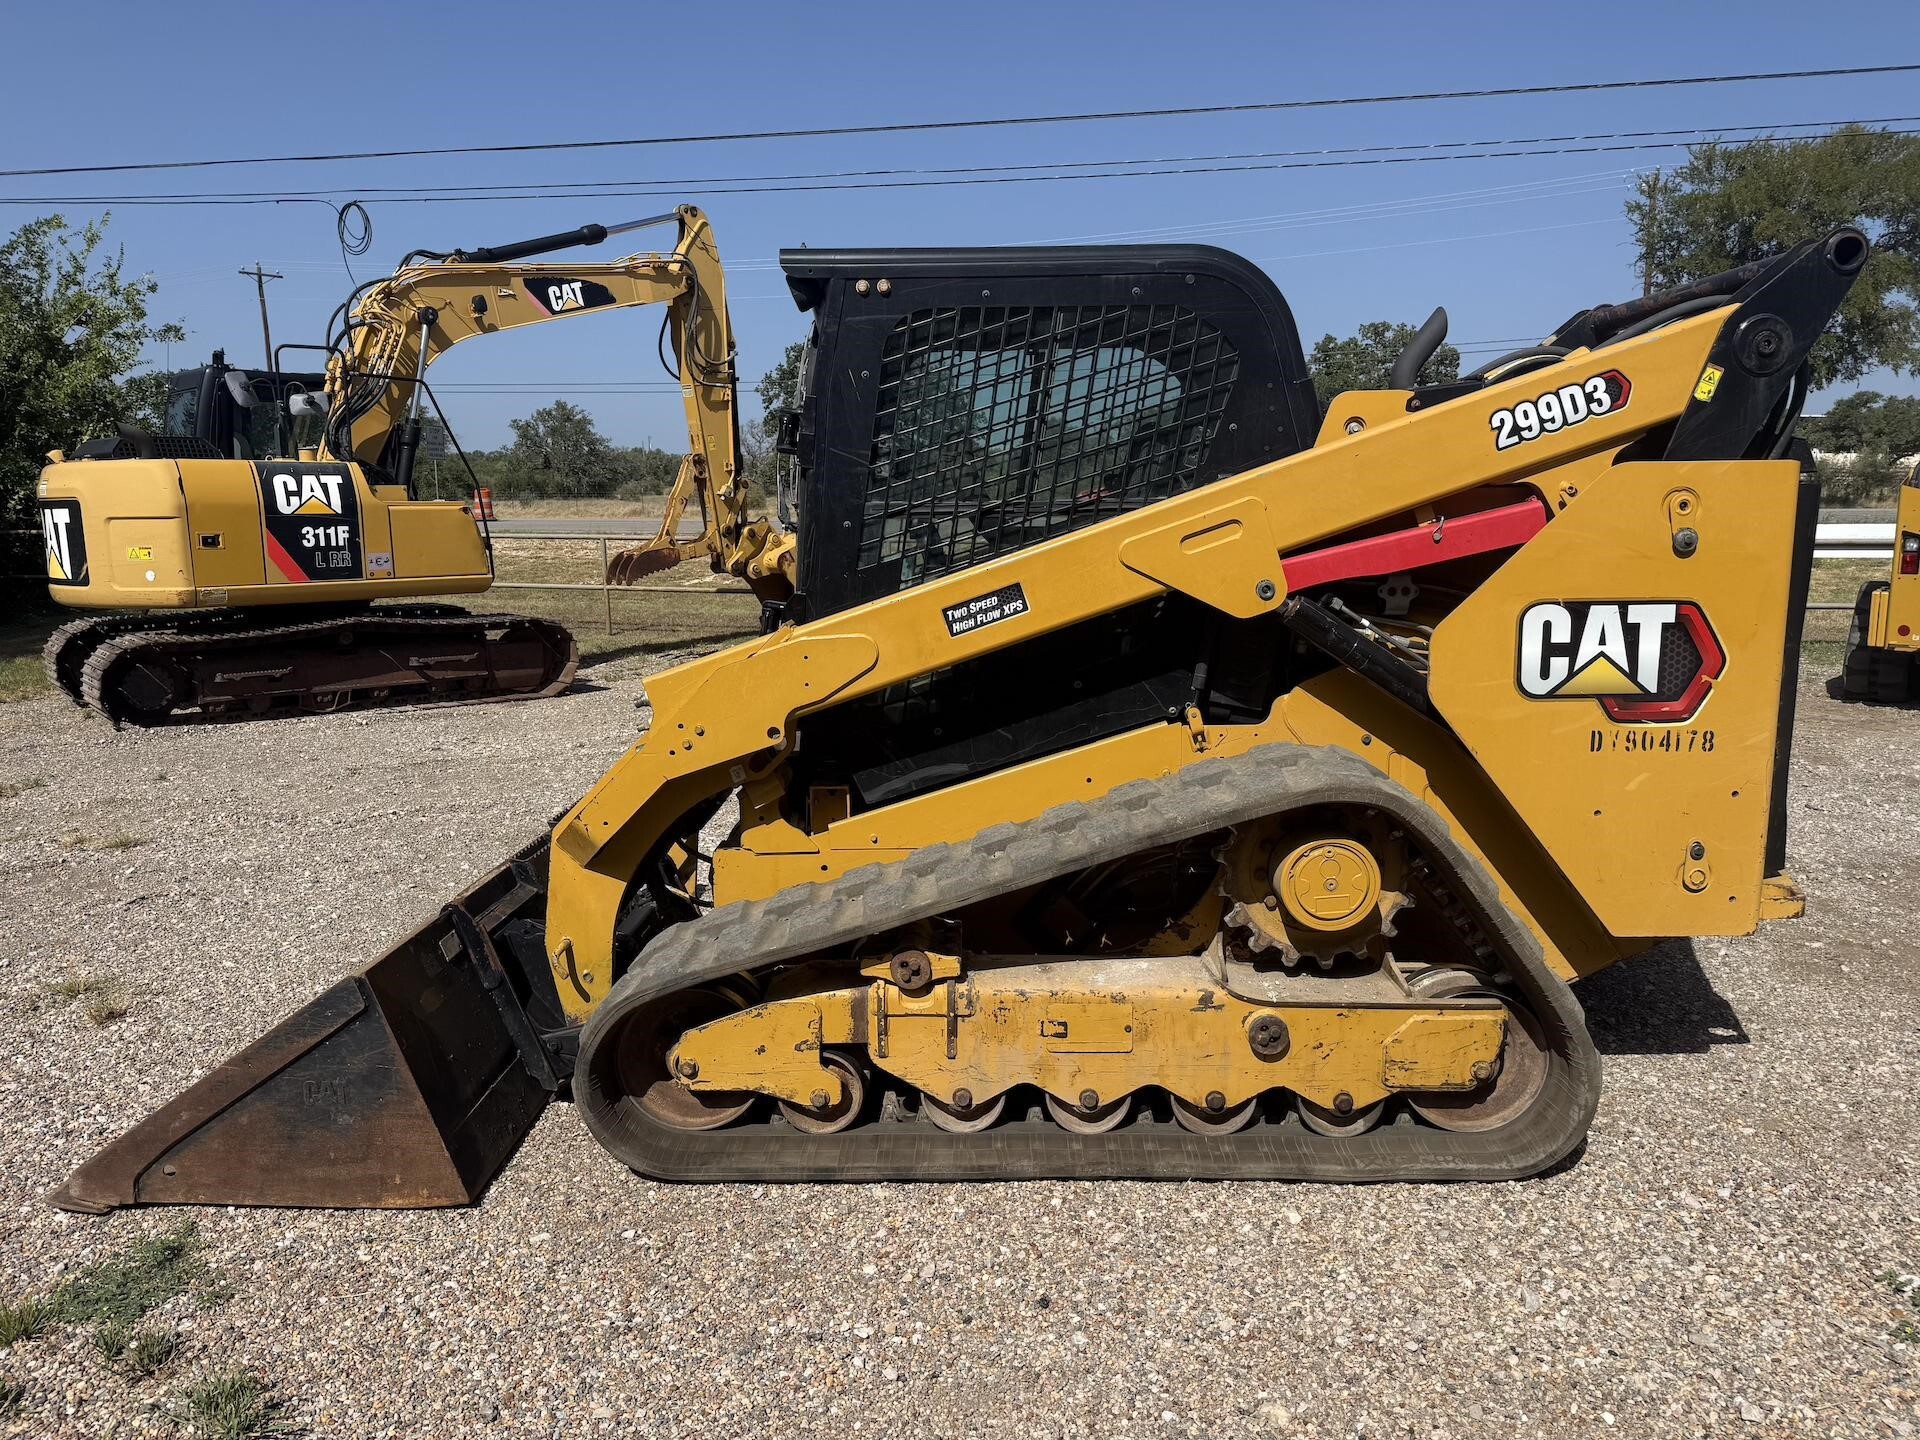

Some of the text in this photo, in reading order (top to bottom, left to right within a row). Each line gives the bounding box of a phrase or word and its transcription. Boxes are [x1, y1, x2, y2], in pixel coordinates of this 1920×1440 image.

[548, 281, 584, 312] CAT
[1491, 376, 1611, 449] 299D3
[273, 474, 343, 514] CAT
[40, 508, 72, 580] AT
[301, 526, 349, 547] 311F
[316, 551, 351, 567] L RR
[947, 597, 998, 621] TWO SPEED
[952, 600, 1023, 633] HIGH FLOW XPS
[1521, 604, 1676, 695] CAT
